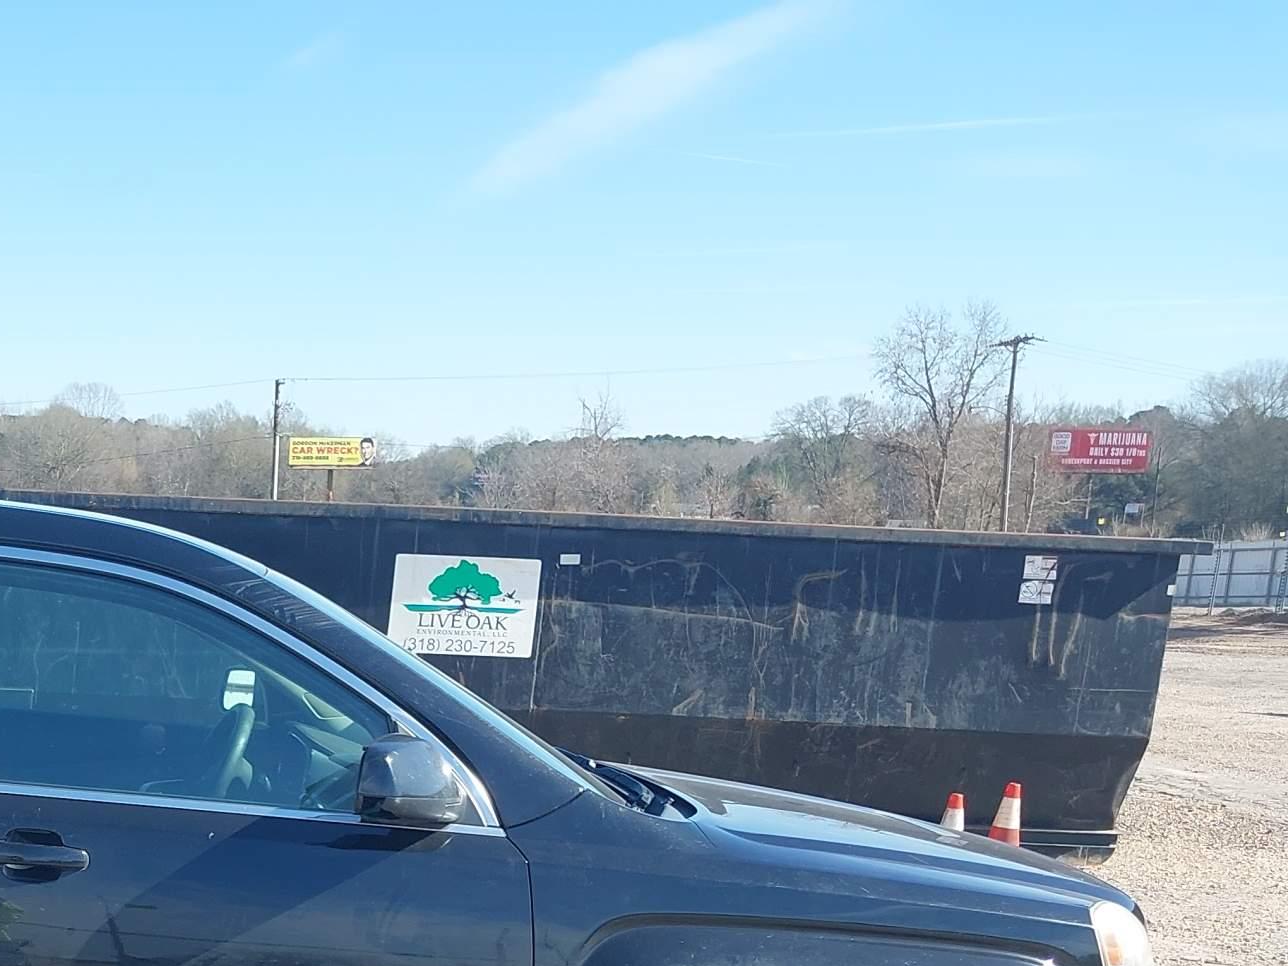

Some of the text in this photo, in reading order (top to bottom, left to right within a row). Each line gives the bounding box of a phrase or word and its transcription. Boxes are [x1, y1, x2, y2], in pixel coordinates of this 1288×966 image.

[1098, 432, 1147, 446] MARIJUANA
[292, 446, 359, 455] CAR WRECK?
[1089, 447, 1109, 457] DAILY
[1110, 447, 1124, 457] $30
[417, 612, 509, 631] LIVE OAK
[445, 638, 516, 655] 230-7125
